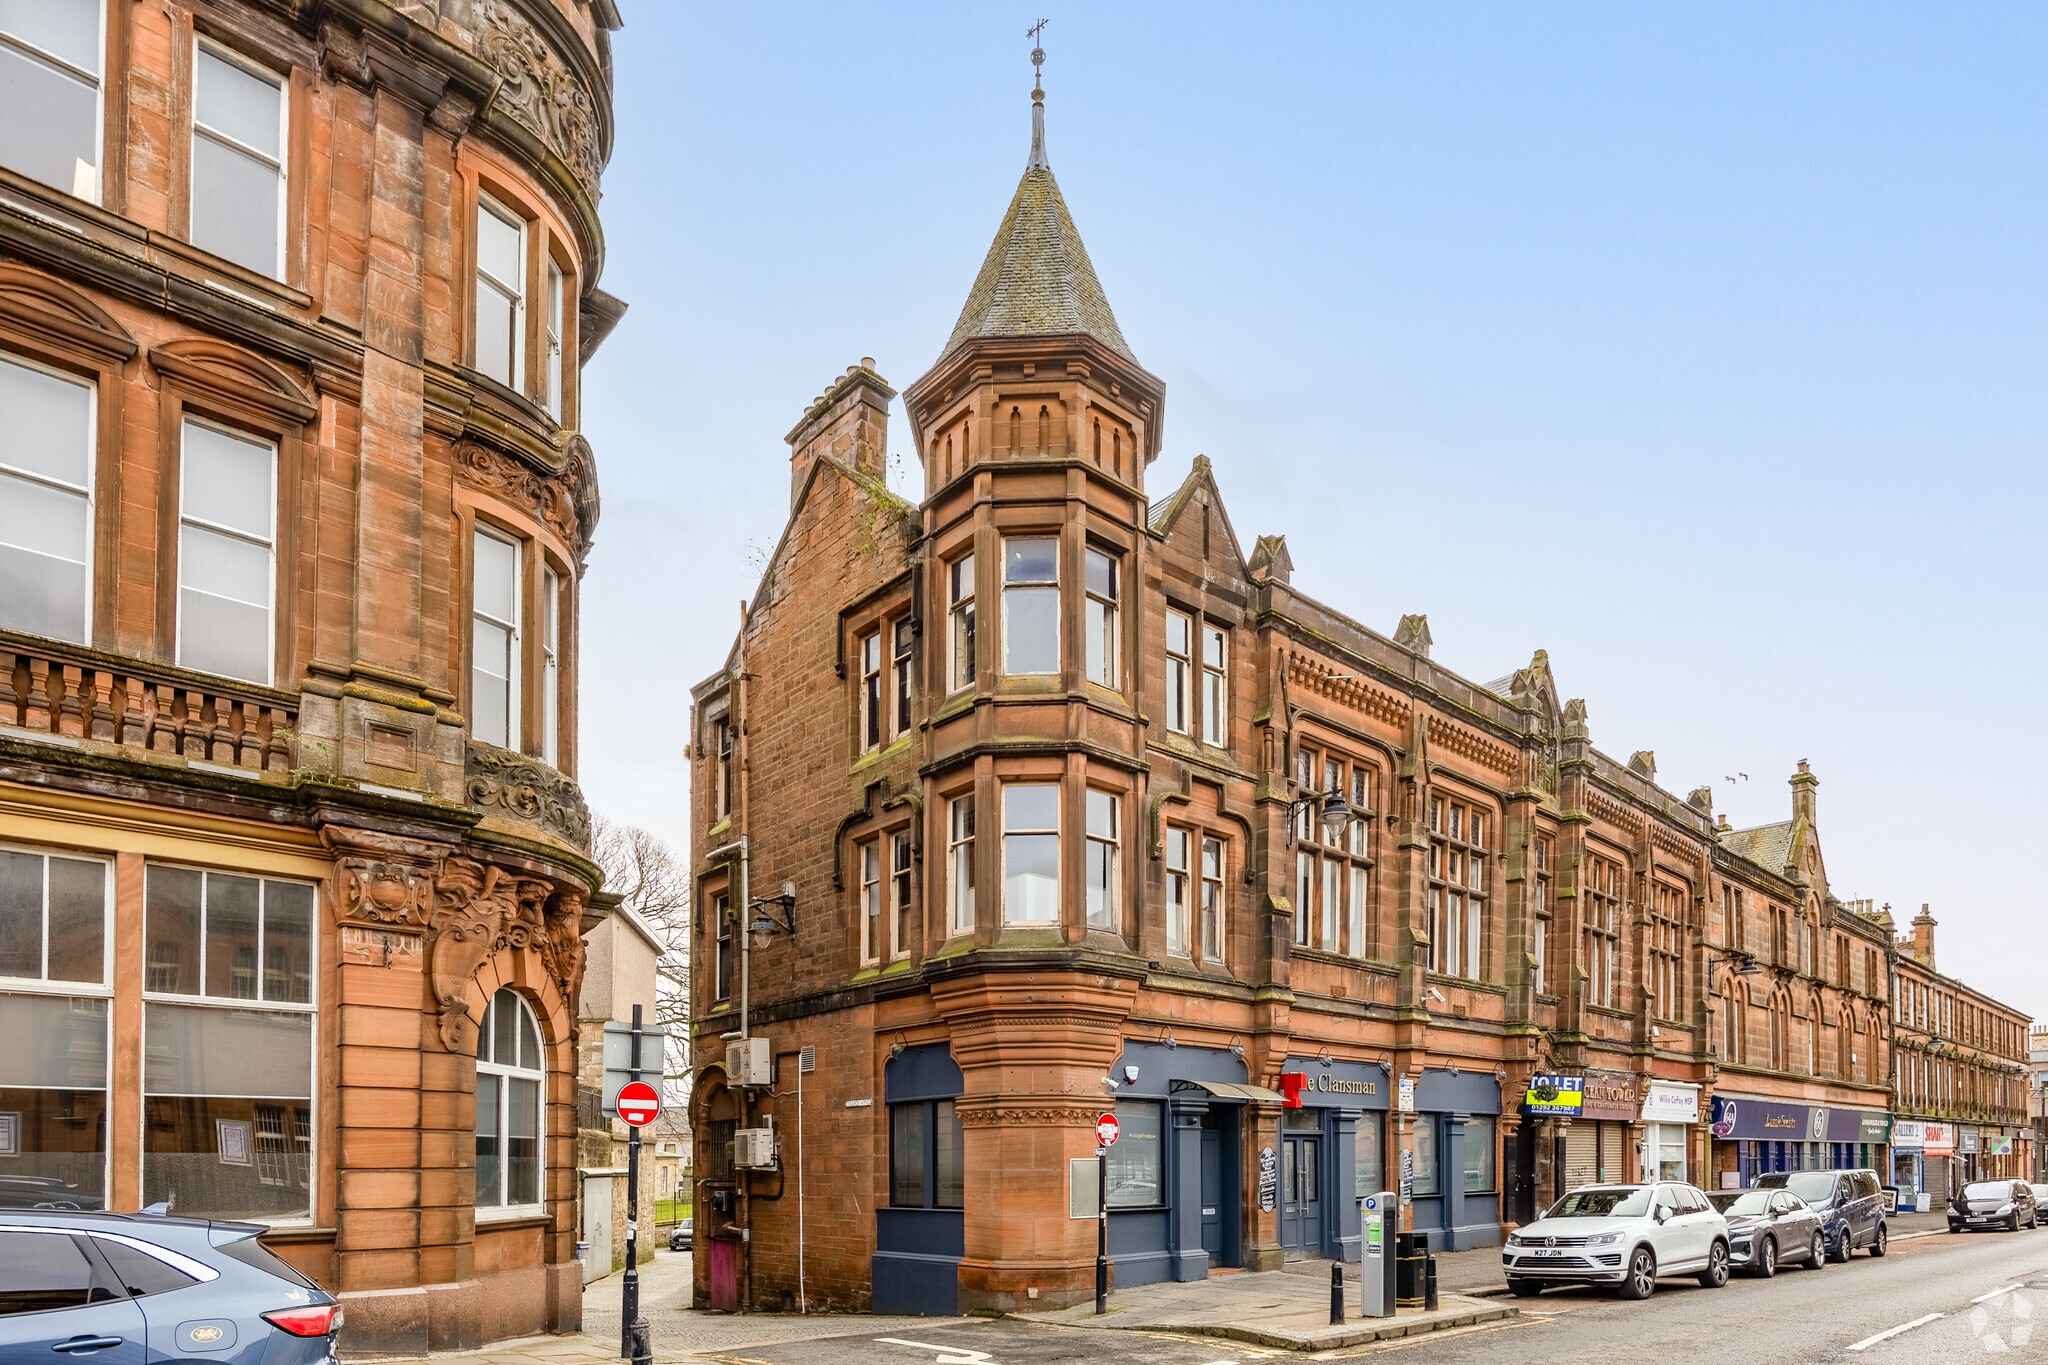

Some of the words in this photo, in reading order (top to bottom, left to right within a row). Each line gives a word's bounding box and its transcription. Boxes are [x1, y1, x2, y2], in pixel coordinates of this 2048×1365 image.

[1317, 1073, 1376, 1096] Clansman
[1554, 1077, 1583, 1091] LET
[1583, 1084, 1606, 1099] CEAN
[1606, 1086, 1636, 1102] TOWER
